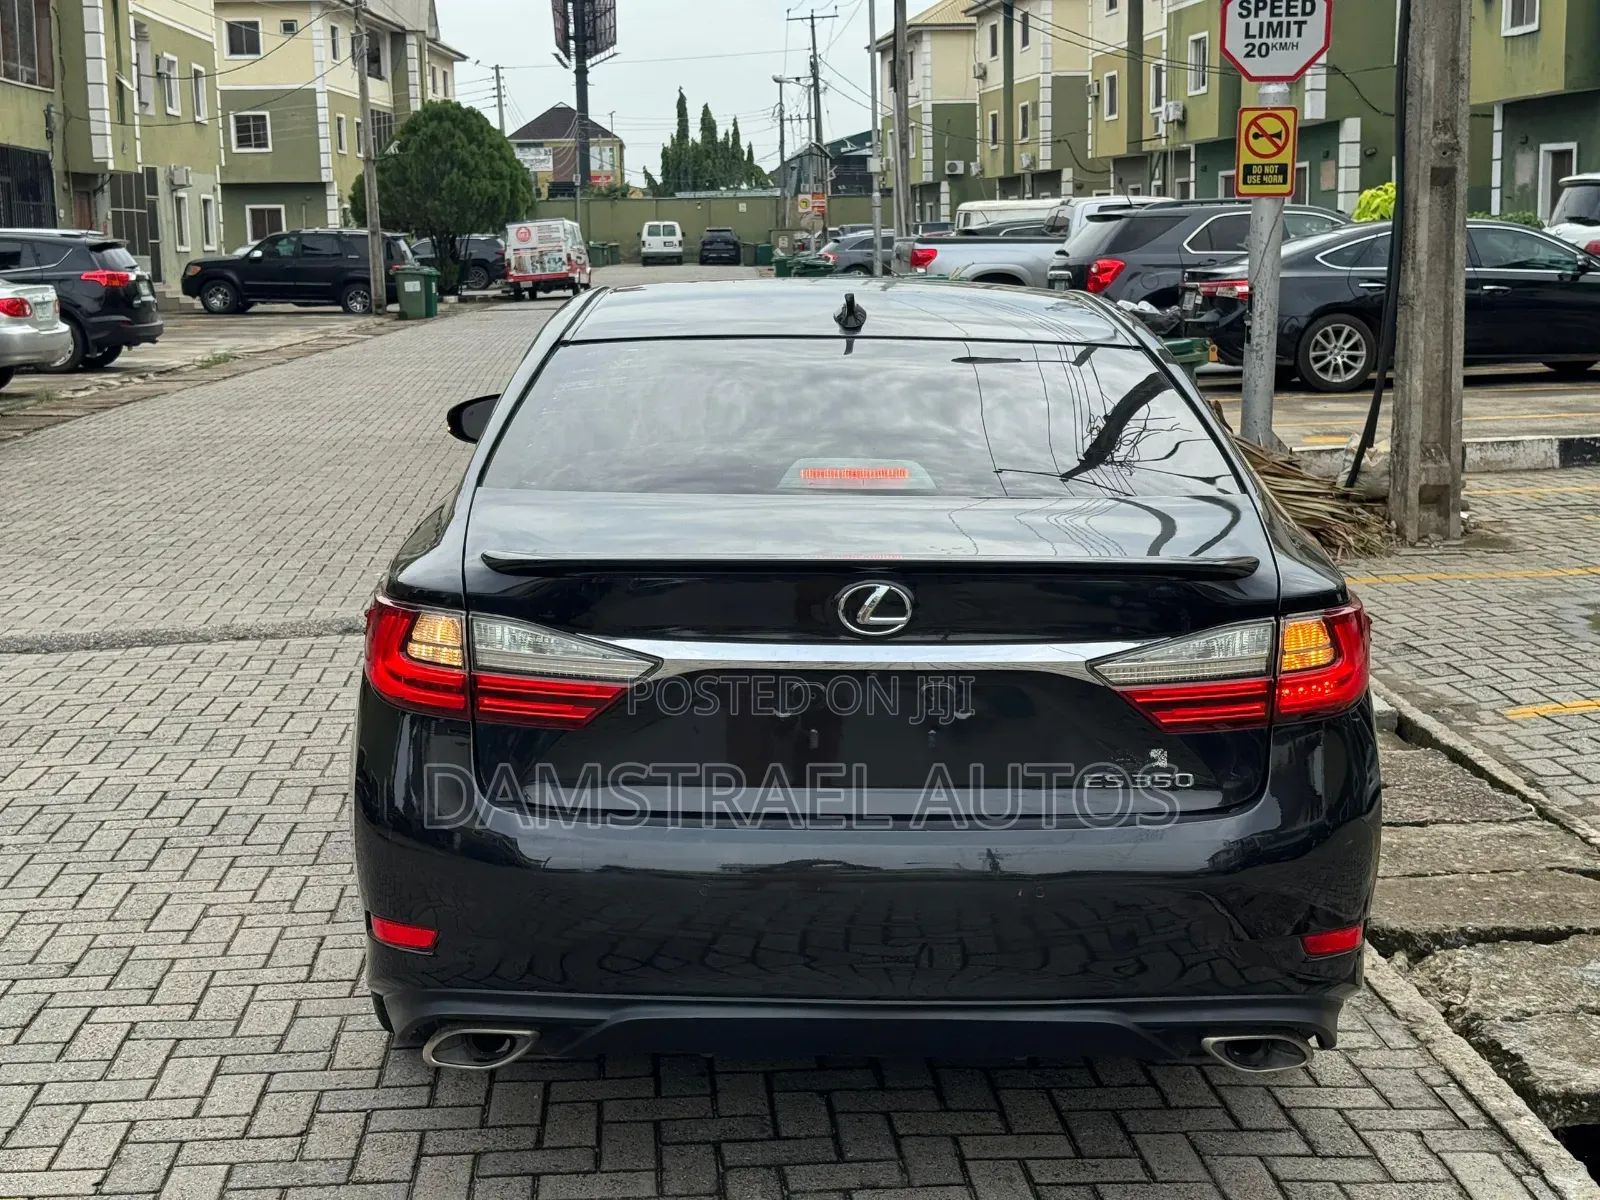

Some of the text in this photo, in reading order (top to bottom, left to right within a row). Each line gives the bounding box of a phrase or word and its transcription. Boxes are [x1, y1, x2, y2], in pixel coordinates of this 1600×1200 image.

[1238, 0, 1316, 19] SPEED
[1244, 20, 1308, 39] LIMIT
[1252, 165, 1279, 174] DO NOT
[1247, 174, 1283, 184] USE HORN
[1084, 773, 1195, 788] ES 350
